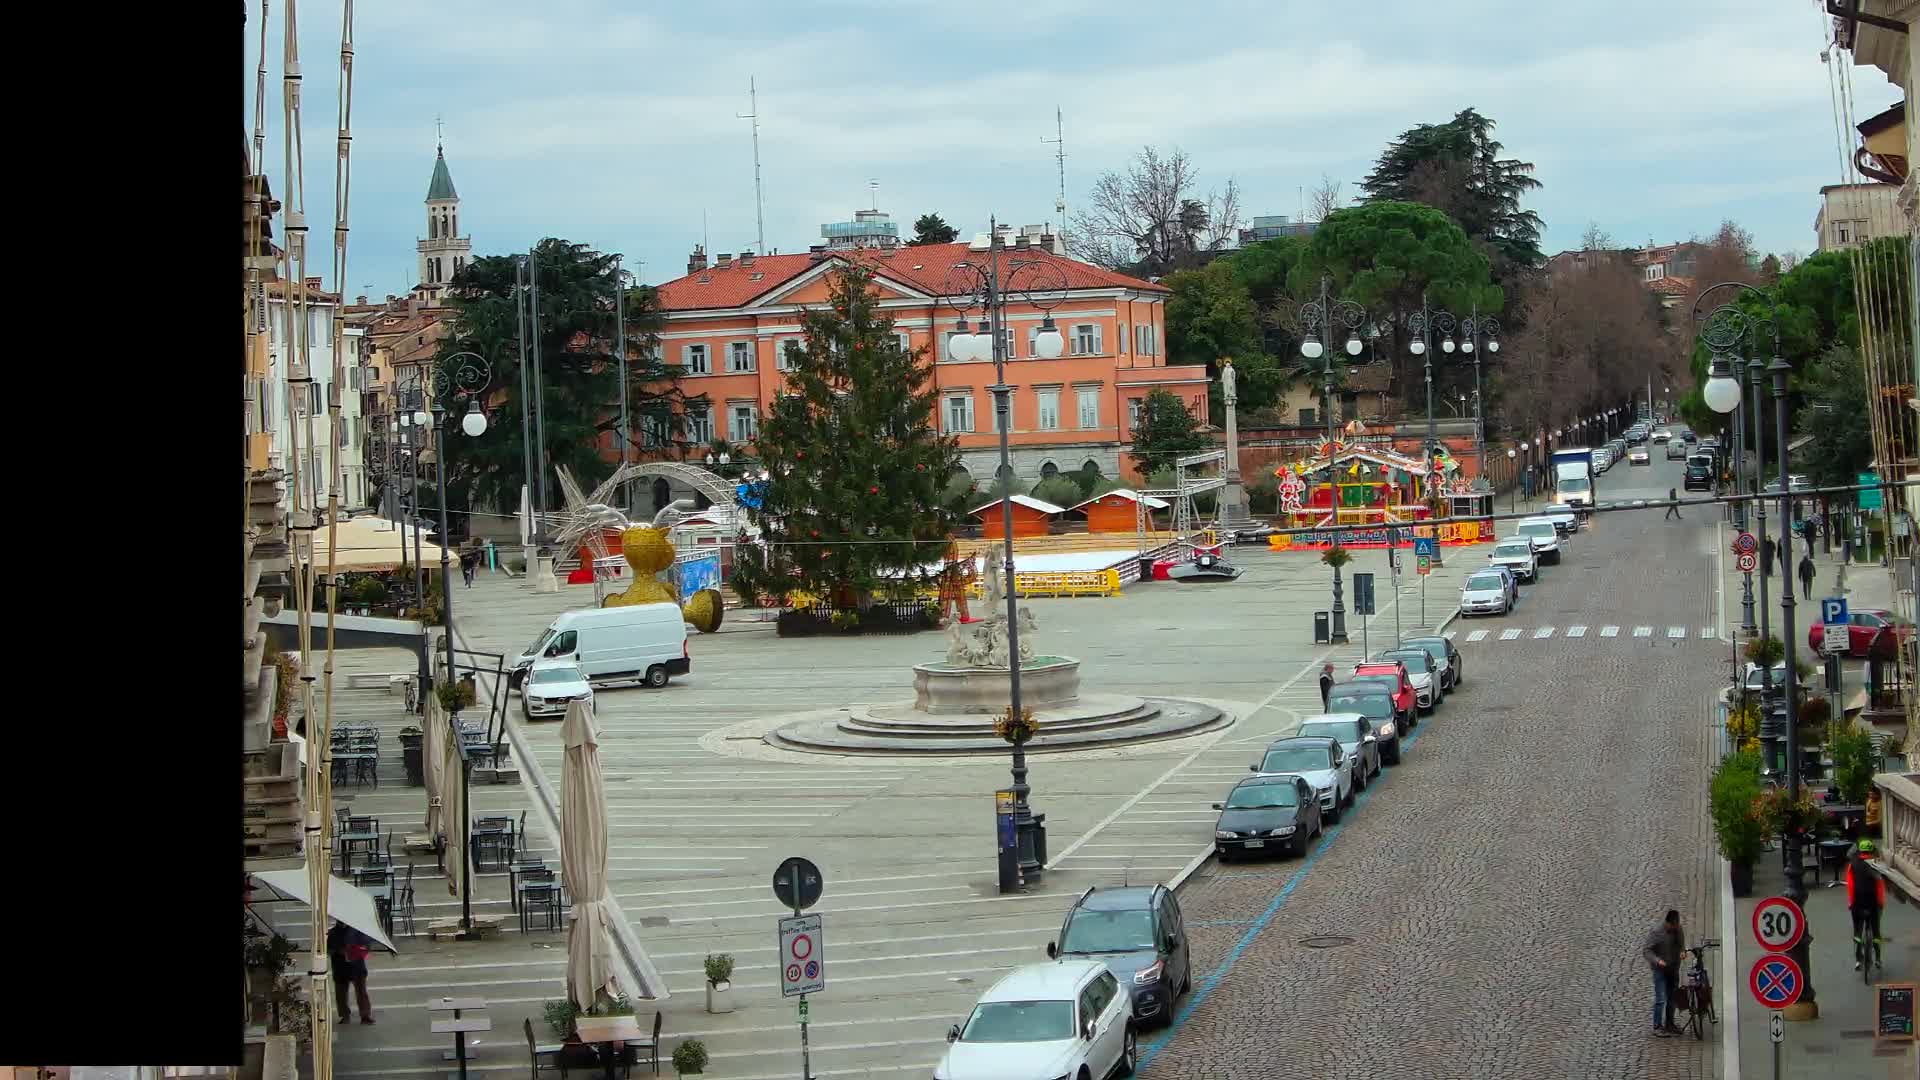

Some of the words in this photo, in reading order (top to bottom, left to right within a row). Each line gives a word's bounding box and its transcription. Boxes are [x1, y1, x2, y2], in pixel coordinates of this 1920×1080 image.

[1743, 557, 1753, 567] 20
[1828, 602, 1841, 622] P
[1762, 911, 1792, 937] 30
